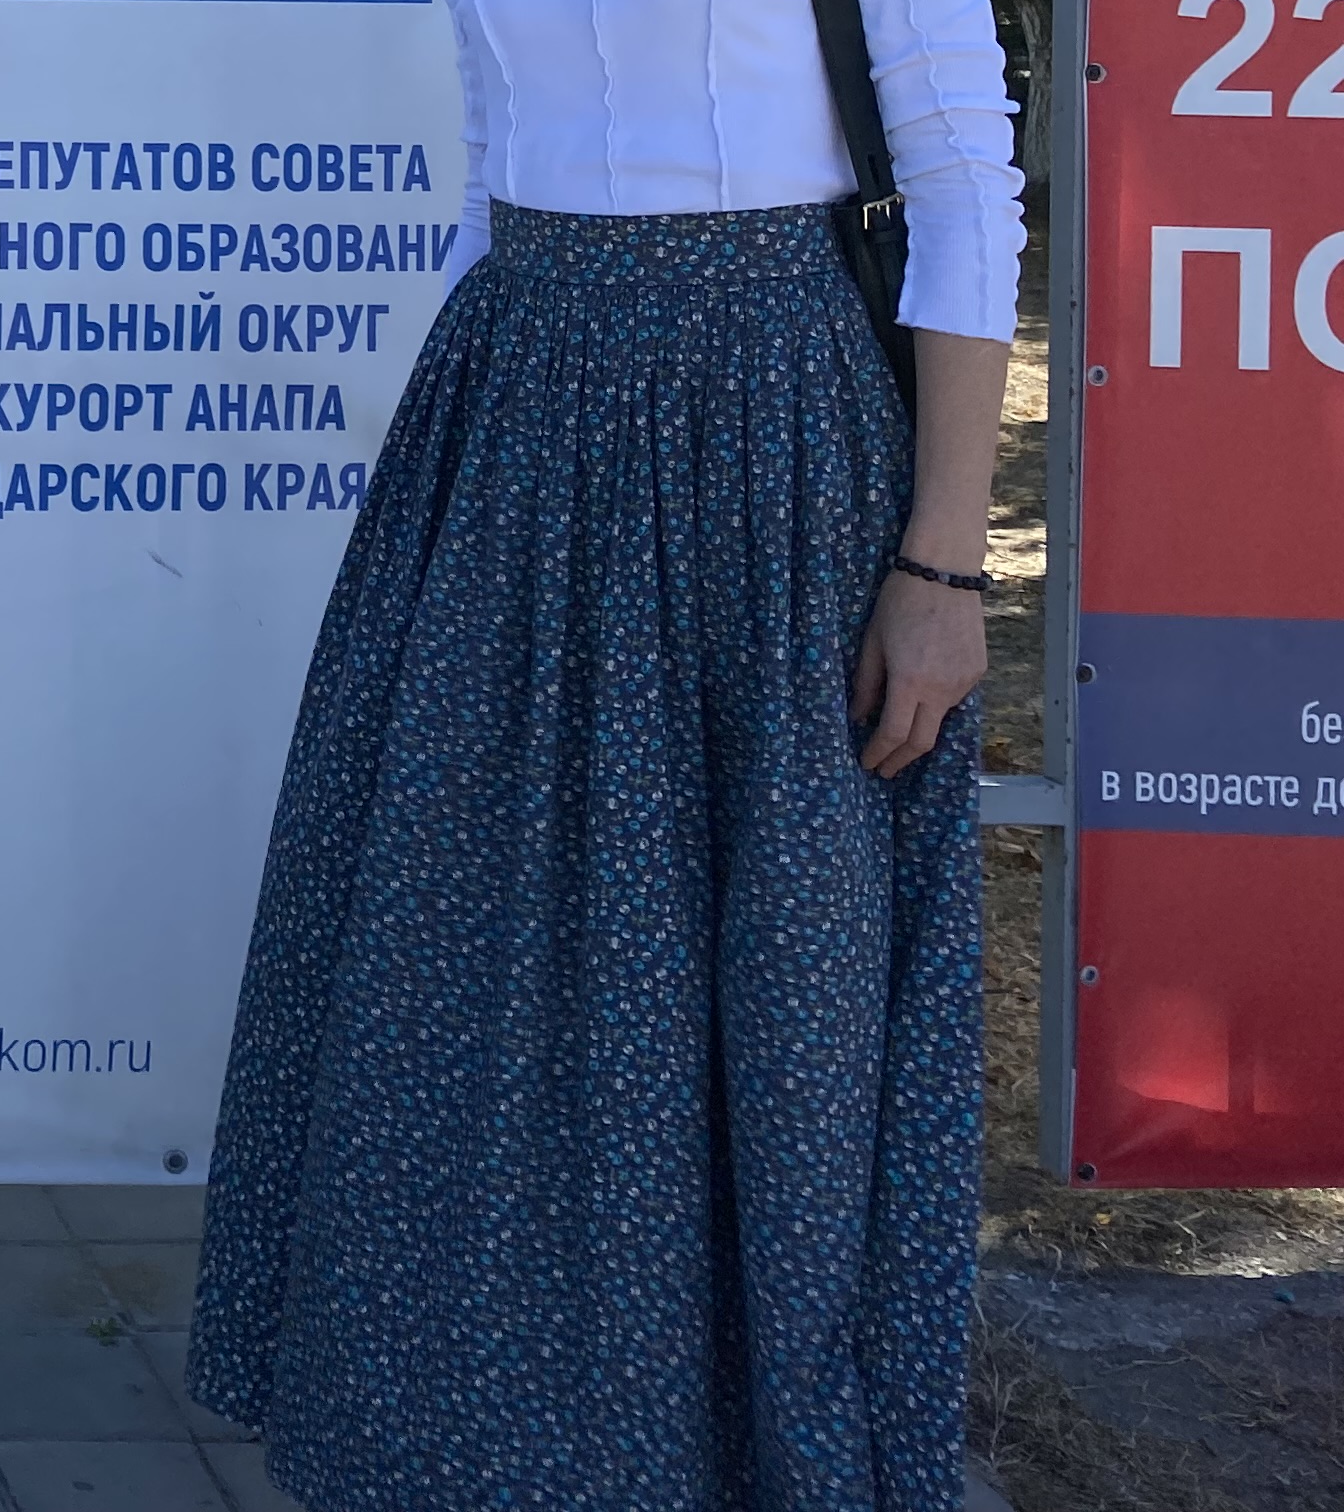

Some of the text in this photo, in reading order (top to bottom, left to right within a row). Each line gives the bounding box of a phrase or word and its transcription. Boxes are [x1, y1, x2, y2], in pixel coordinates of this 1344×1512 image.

[251, 142, 432, 192] СОВЕТА
[238, 303, 390, 353] ОКРУГ
[185, 383, 346, 432] АНАПА
[244, 462, 366, 511] КРАЯ
[1102, 770, 1344, 816] в возрасте д
